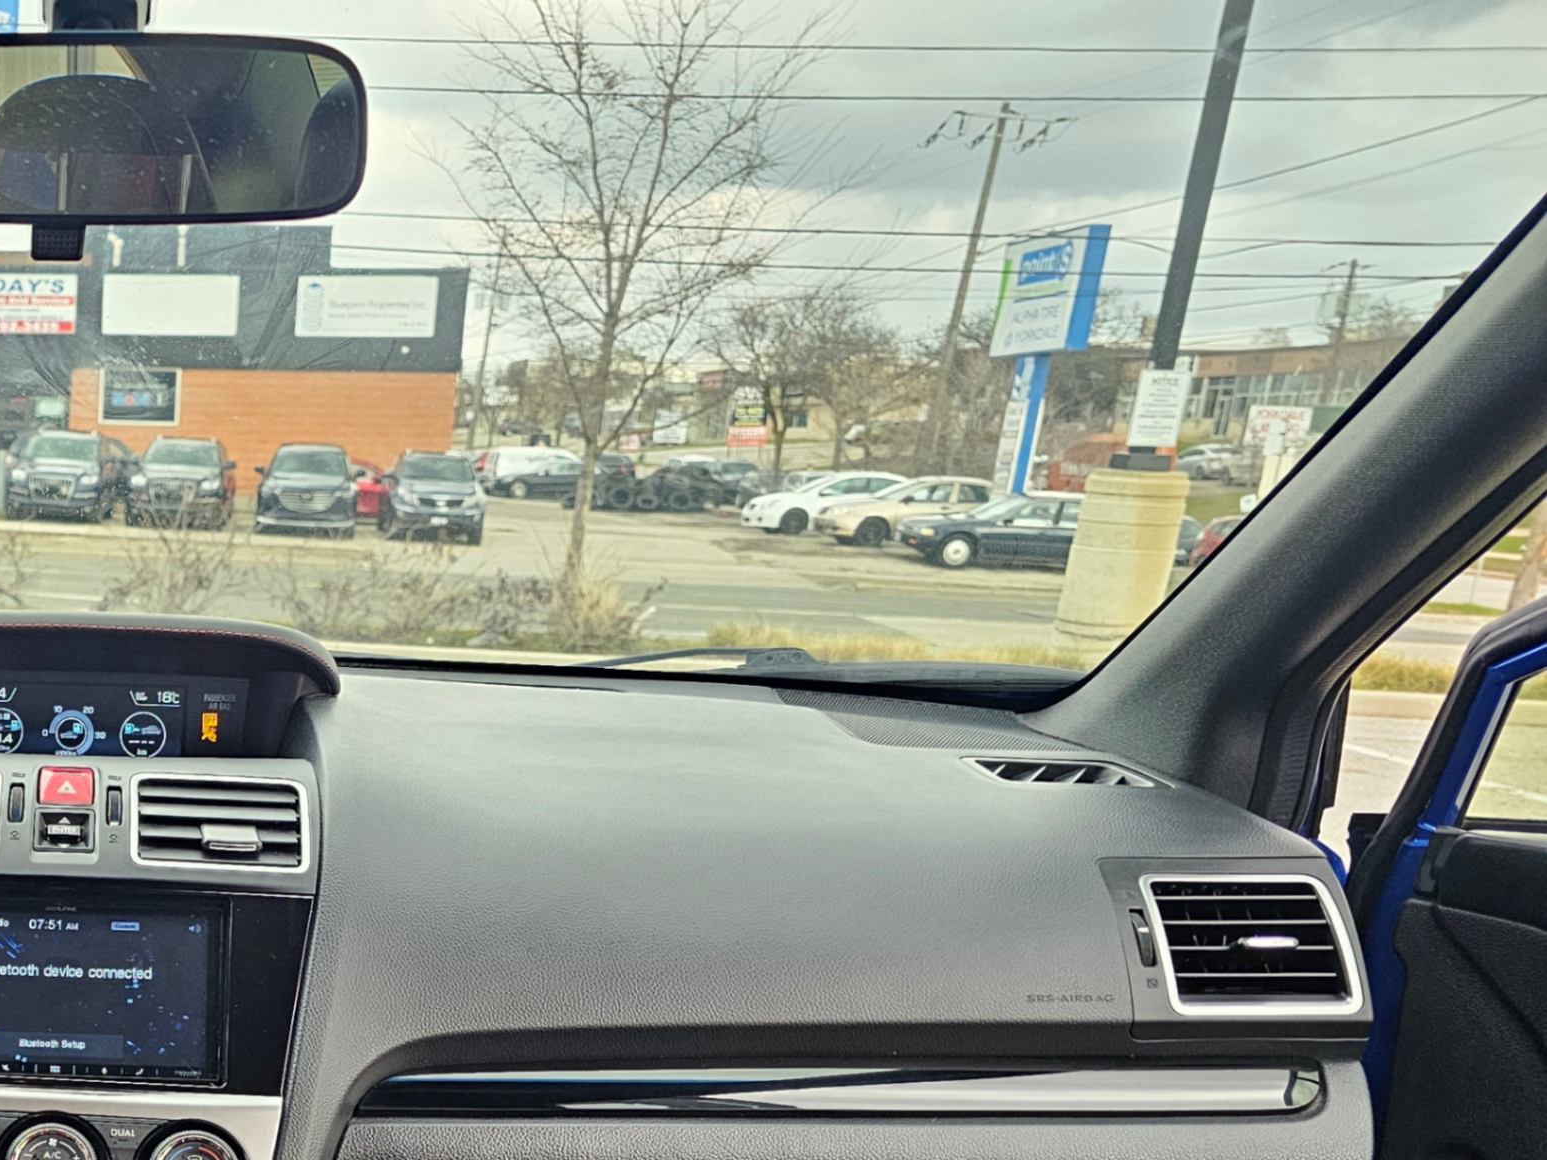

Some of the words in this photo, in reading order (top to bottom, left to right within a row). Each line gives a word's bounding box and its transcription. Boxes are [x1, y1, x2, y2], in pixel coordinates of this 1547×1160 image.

[28, 918, 63, 931] 07:51
[66, 923, 79, 931] AM
[43, 964, 83, 979] device
[88, 966, 153, 980] connected
[19, 1038, 59, 1049] Bluetooth
[61, 1039, 86, 1050] Setup
[111, 1128, 135, 1137] DUAL
[43, 1150, 62, 1160] A/C
